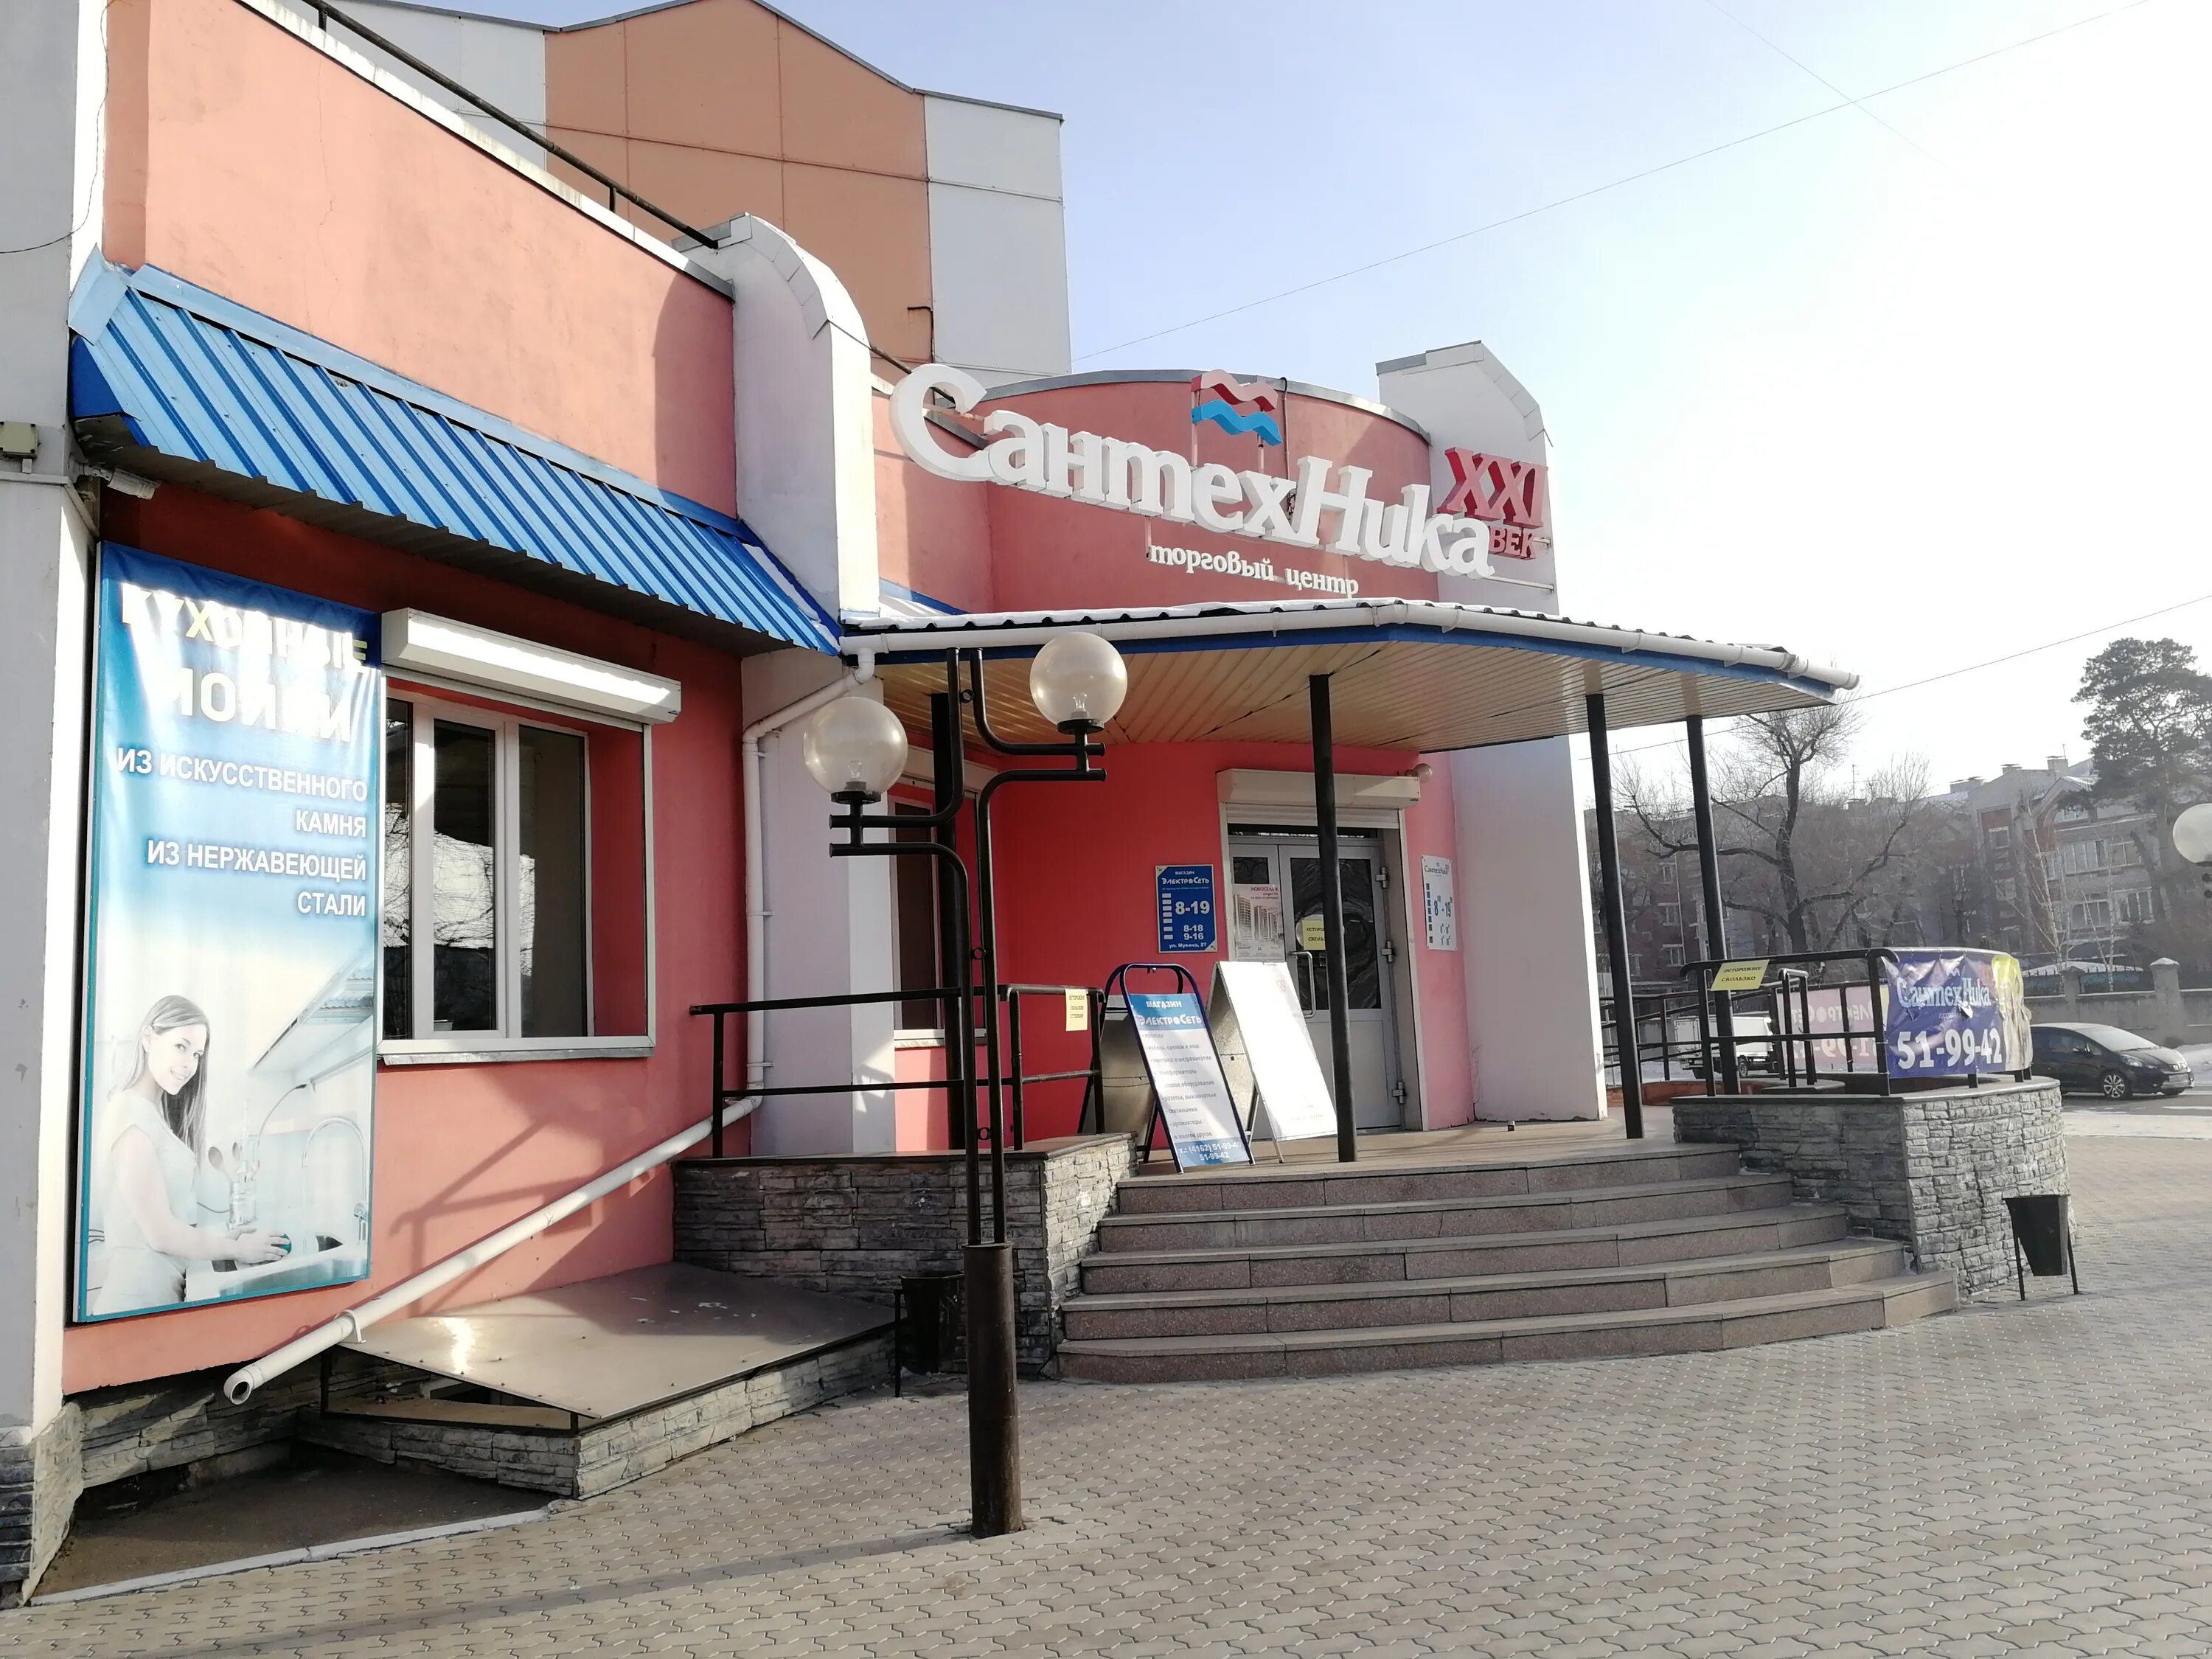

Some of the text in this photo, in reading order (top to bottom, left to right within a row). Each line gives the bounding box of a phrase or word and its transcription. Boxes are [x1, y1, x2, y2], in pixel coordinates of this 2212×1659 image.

[888, 363, 1495, 580] СантехНика
[1437, 447, 1548, 529] XXI
[1488, 526, 1537, 560] ВЕК
[1149, 544, 1359, 599] торговый центр
[116, 747, 368, 803] ИЗ ИСКУССТВЕННОГО
[296, 809, 367, 838] КАМНЯ
[147, 840, 367, 883] ИЗ НЕРЖАВЕЮЩЕЙ
[296, 891, 366, 917] СТАЛИ
[1175, 900, 1210, 915] 8-19
[1183, 924, 1204, 932] 8-18
[1146, 1001, 1183, 1009] МАГАЗИН
[1896, 1028, 2003, 1070] 51-99-42
